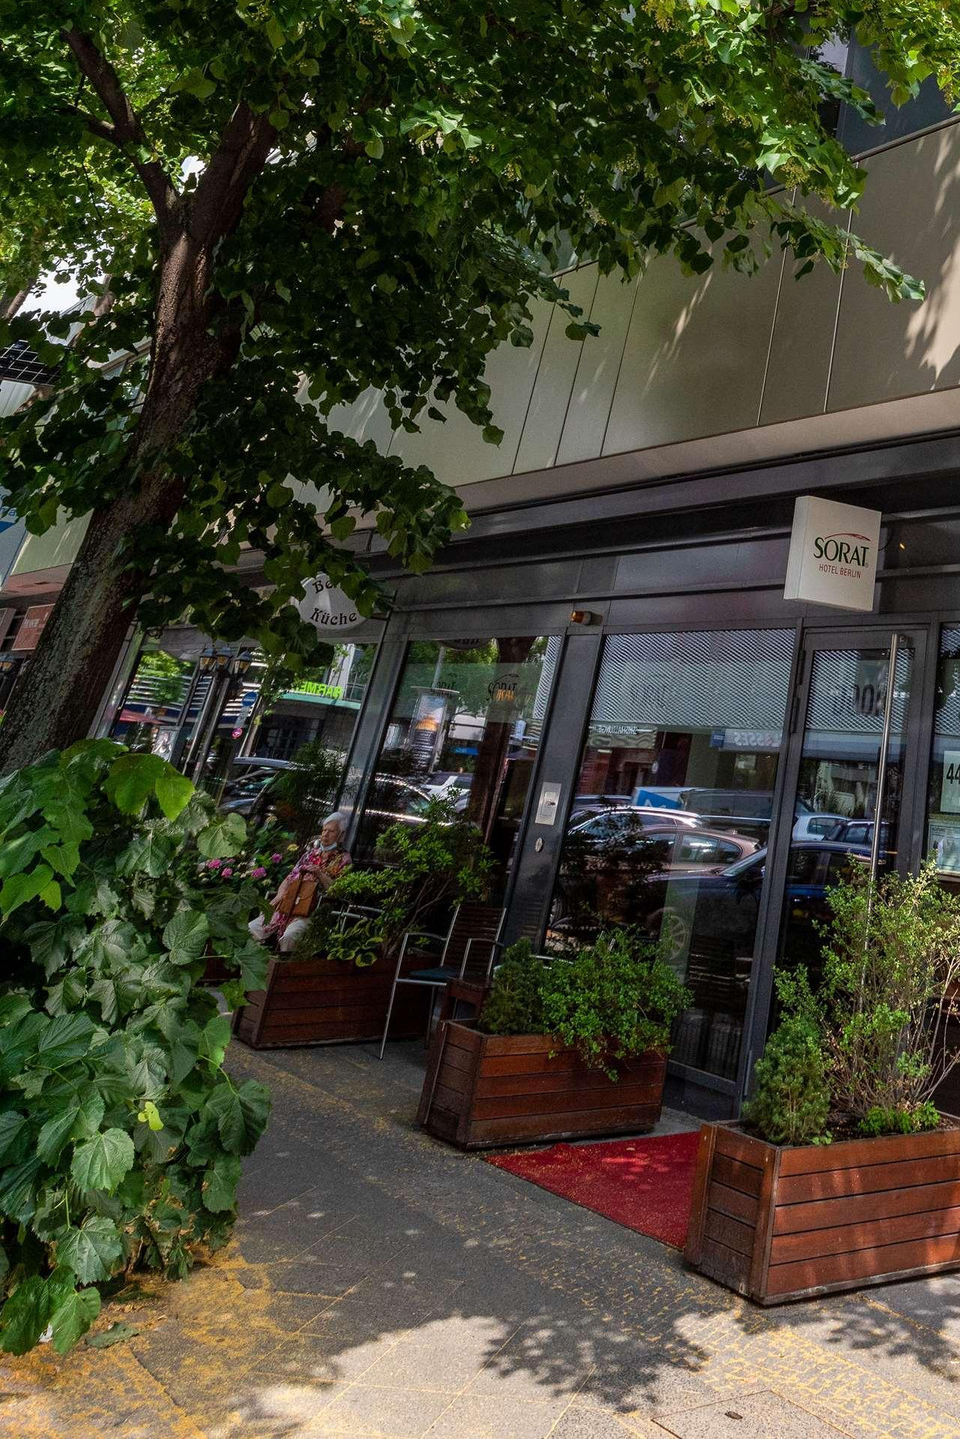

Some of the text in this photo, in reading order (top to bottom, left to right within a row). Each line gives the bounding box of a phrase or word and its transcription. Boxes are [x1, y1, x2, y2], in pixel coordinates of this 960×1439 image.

[813, 536, 870, 567] SORAT
[818, 563, 862, 579] HOTEL BERLIN
[310, 607, 357, 625] Küche
